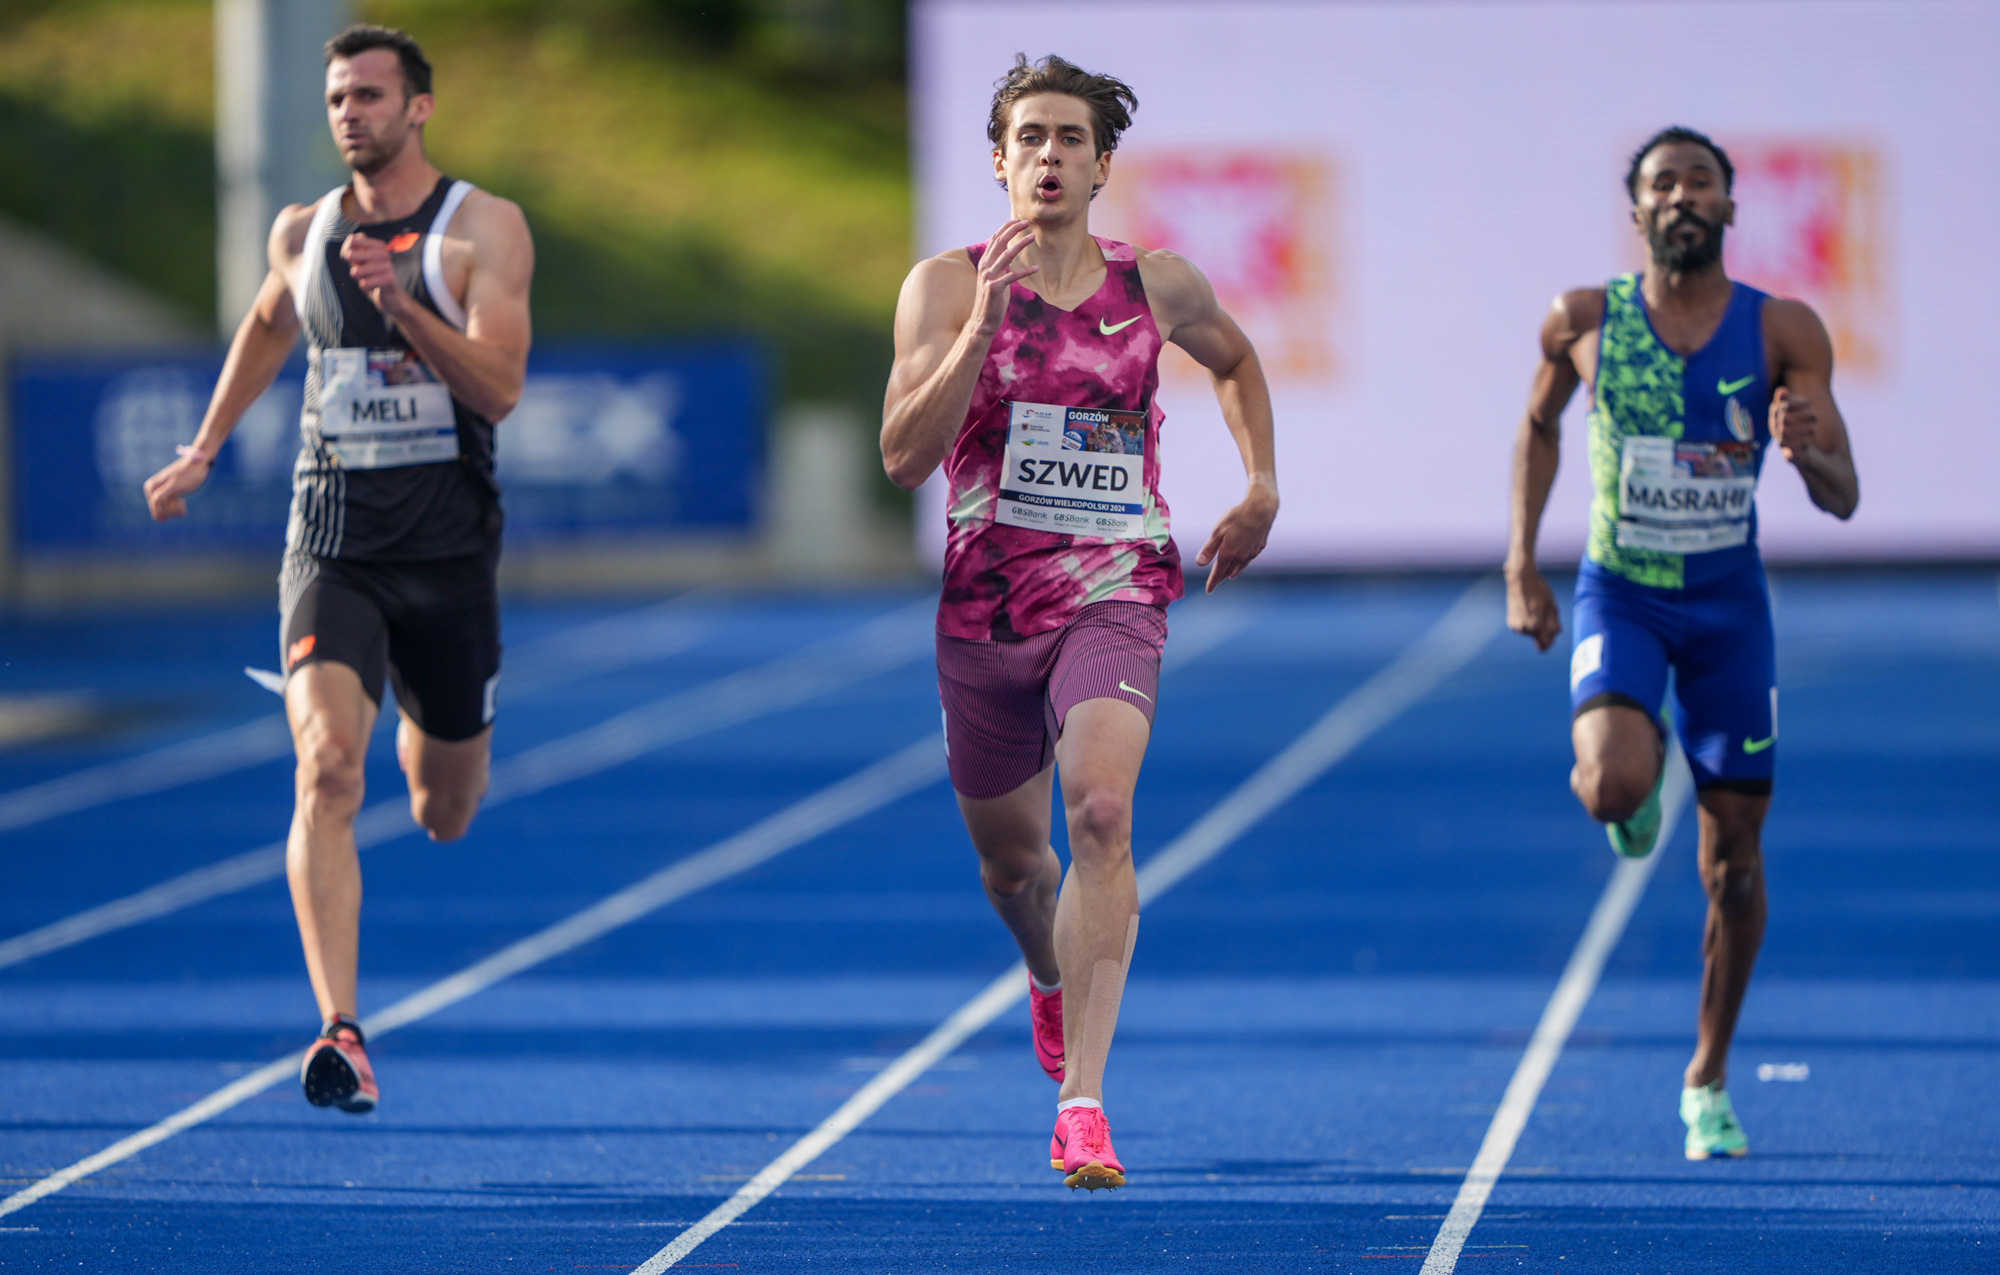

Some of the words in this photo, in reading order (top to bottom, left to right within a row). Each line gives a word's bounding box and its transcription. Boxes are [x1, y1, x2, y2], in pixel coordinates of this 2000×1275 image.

[352, 398, 417, 422] MELI
[1068, 410, 1109, 422] GORZÓW
[1068, 421, 1094, 431] 2024
[1017, 458, 1129, 491] SZWED
[1018, 494, 1054, 505] GORZÓW
[1054, 499, 1109, 511] WIELKOPOLSKI
[1110, 504, 1126, 513] 2024
[1628, 485, 1747, 510] MASRAHI
